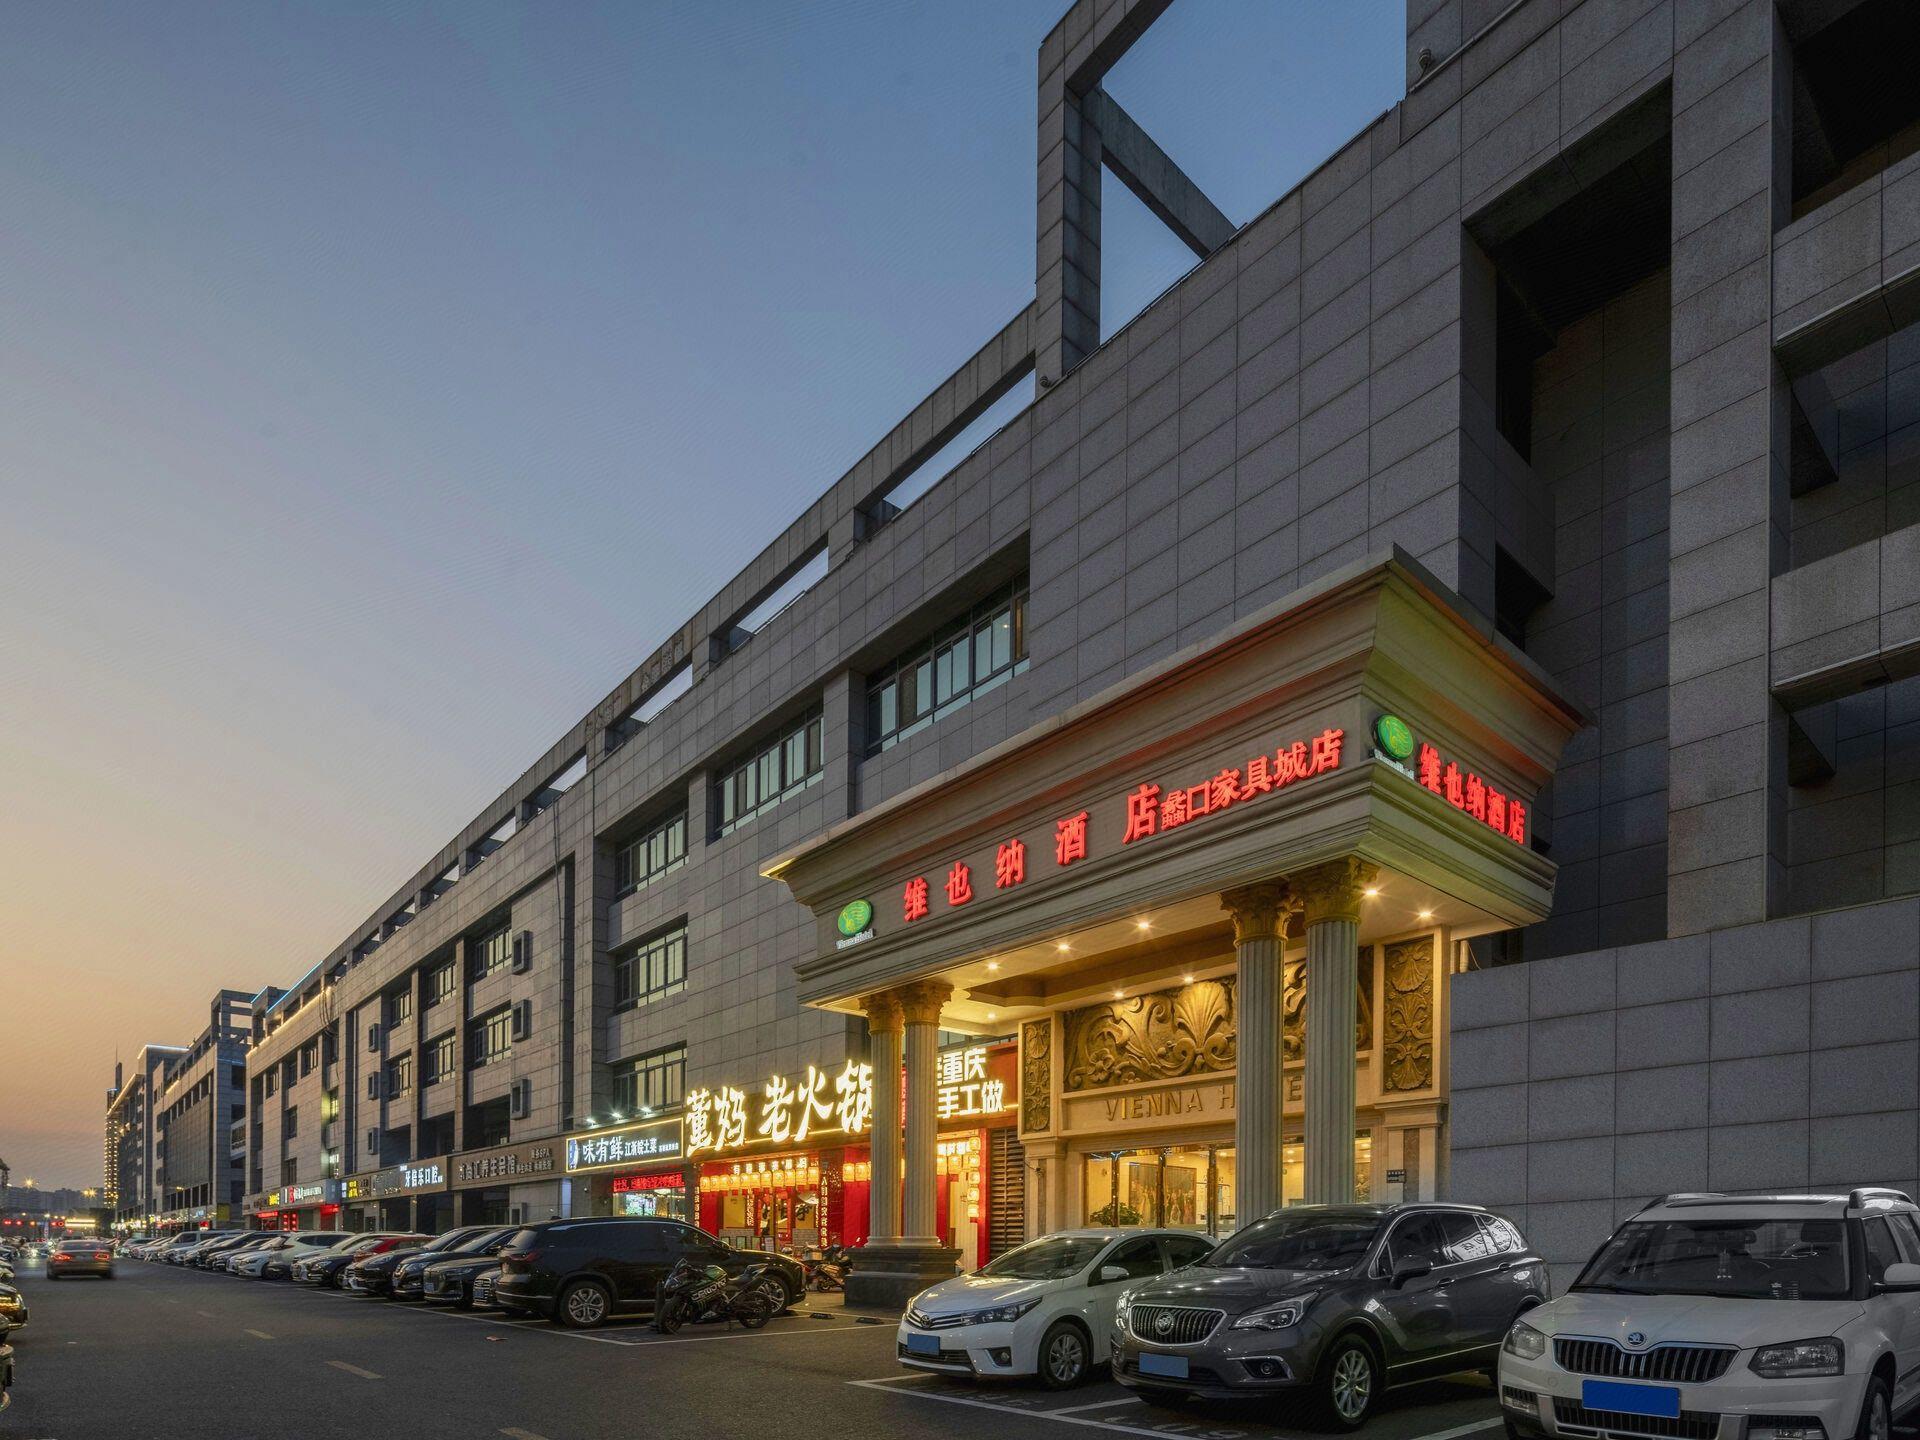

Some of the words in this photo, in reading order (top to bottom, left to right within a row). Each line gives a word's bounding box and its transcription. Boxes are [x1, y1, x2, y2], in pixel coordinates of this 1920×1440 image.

[904, 783, 1160, 923] 维也纳酒店
[1160, 729, 1344, 831] 蠡口家具城店
[1420, 742, 1526, 846] 维也纳酒店
[1105, 1089, 1204, 1121] VIENNA
[583, 1136, 624, 1164] 味有鲜
